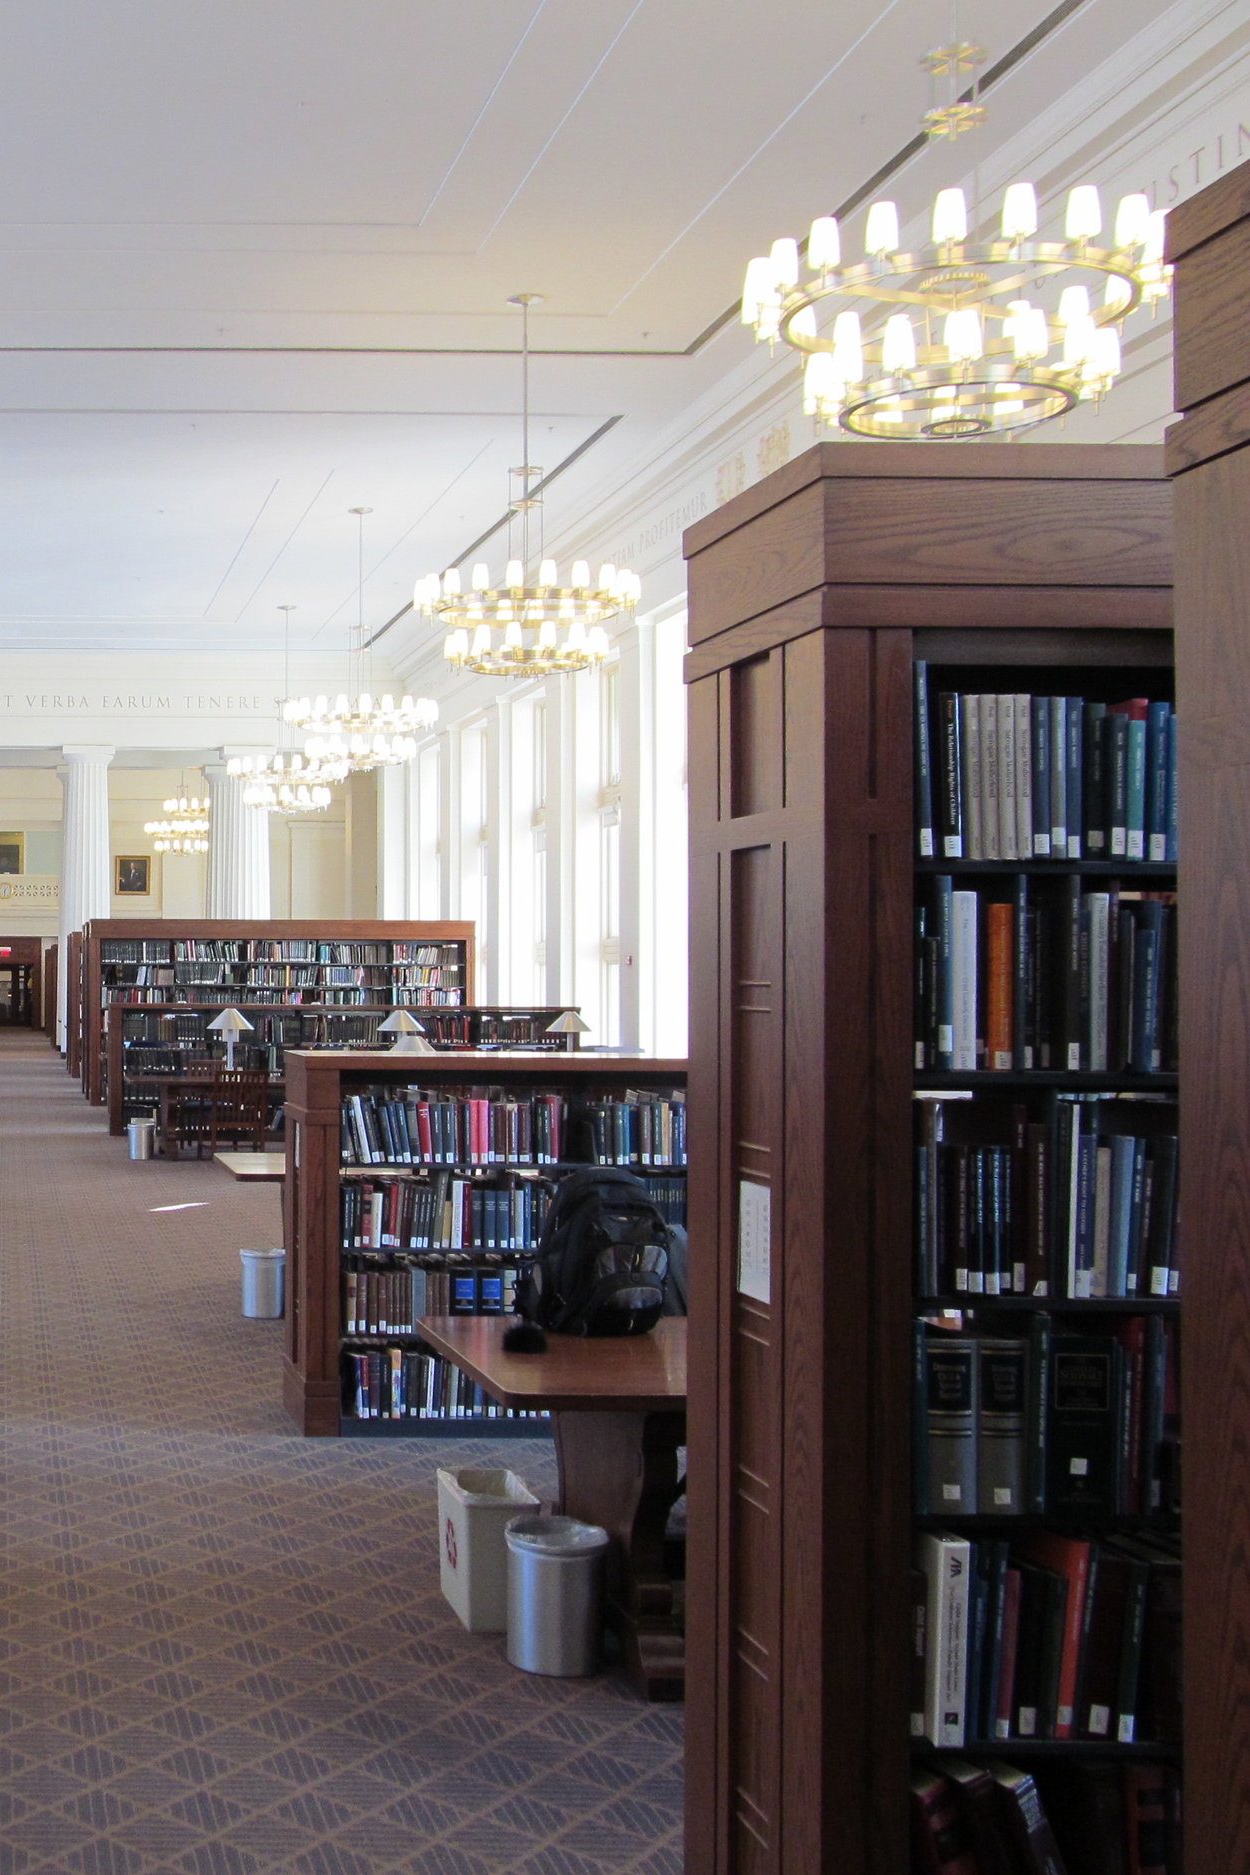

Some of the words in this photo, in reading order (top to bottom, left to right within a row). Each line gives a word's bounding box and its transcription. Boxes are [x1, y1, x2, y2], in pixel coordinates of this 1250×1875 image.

[25, 695, 91, 709] VERBA
[101, 695, 171, 709] EARUM
[182, 696, 261, 710] TENERE
[947, 735, 955, 771] Relationship
